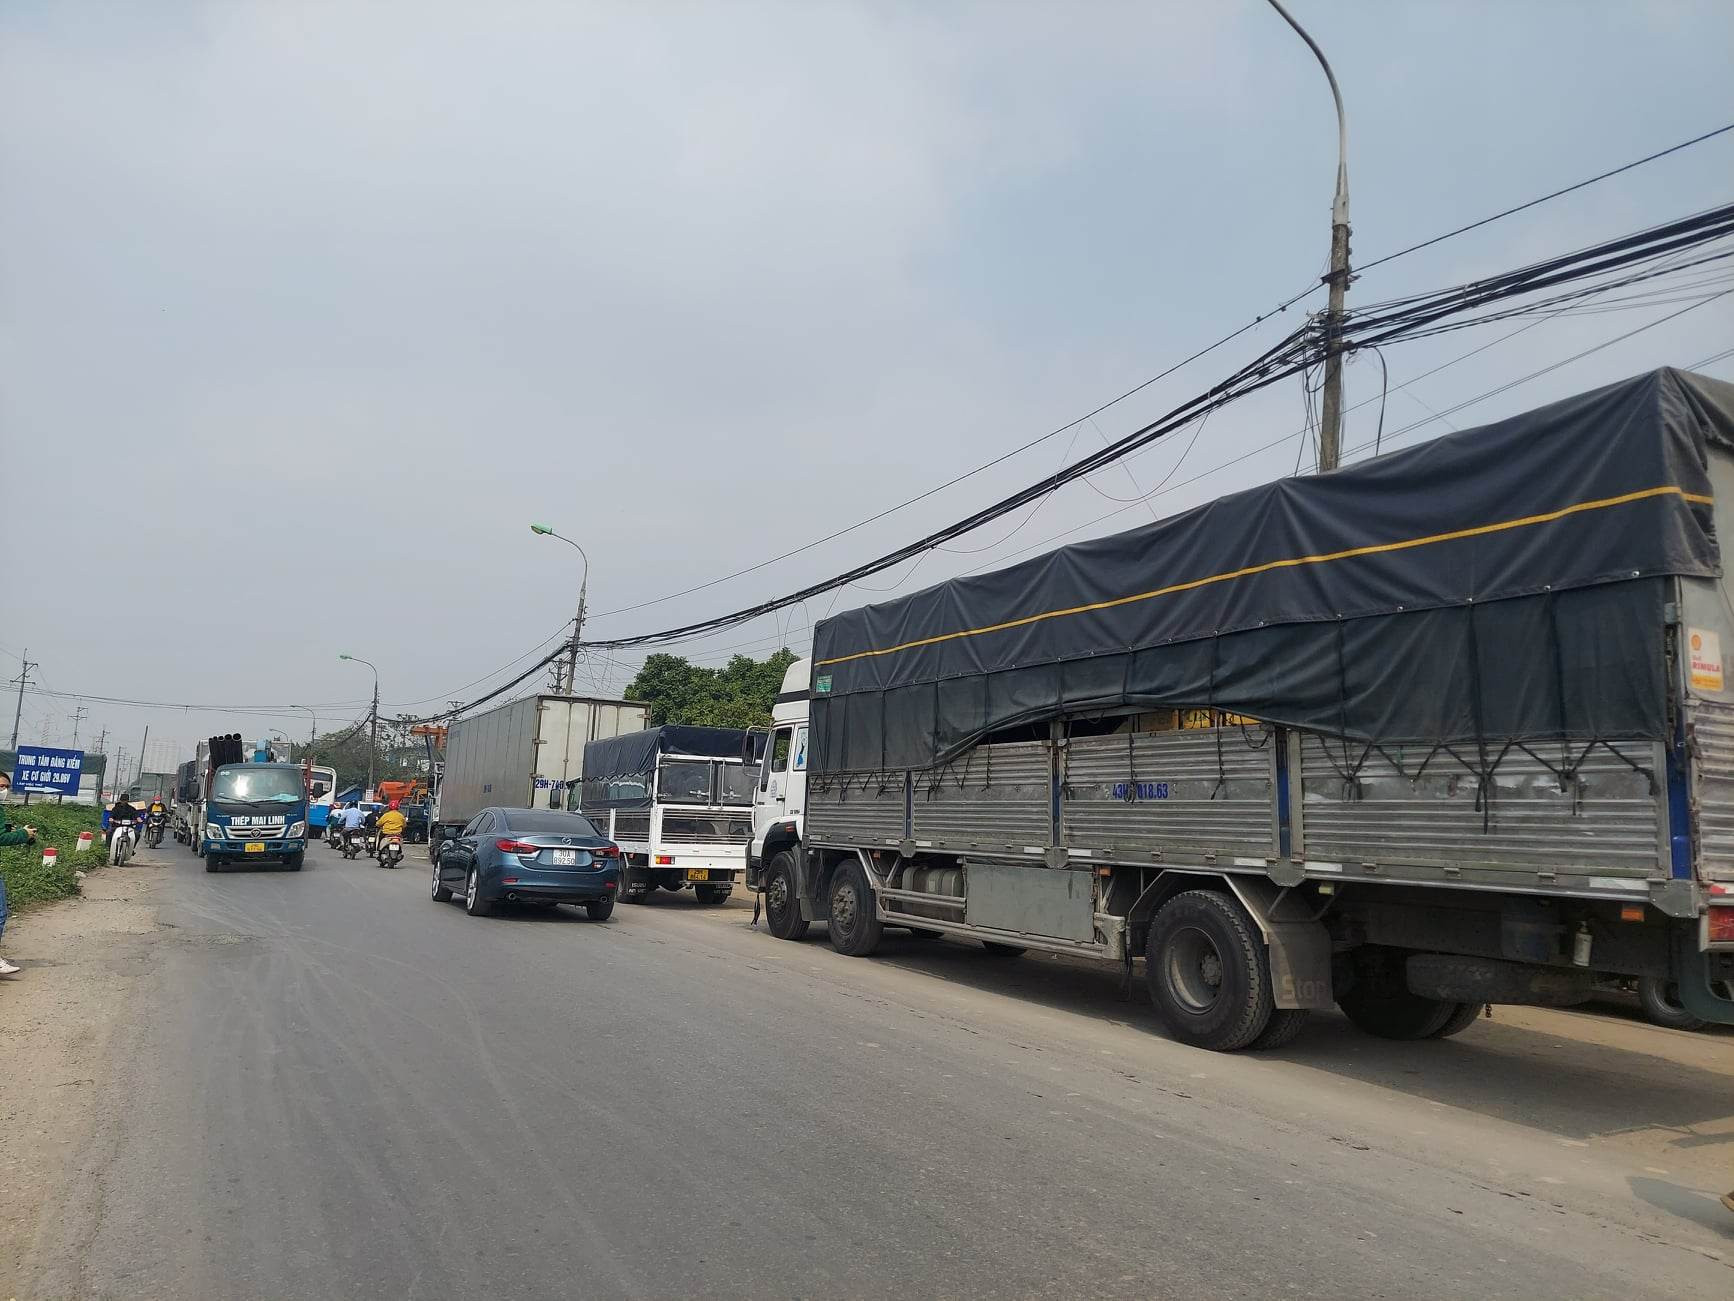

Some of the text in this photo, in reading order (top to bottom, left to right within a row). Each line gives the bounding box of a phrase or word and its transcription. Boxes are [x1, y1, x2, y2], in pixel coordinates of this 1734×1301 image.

[18, 754, 36, 766] TRUNG
[22, 770, 30, 781] XE
[231, 815, 285, 826] THÉP MAI LINH
[558, 850, 571, 858] 30A
